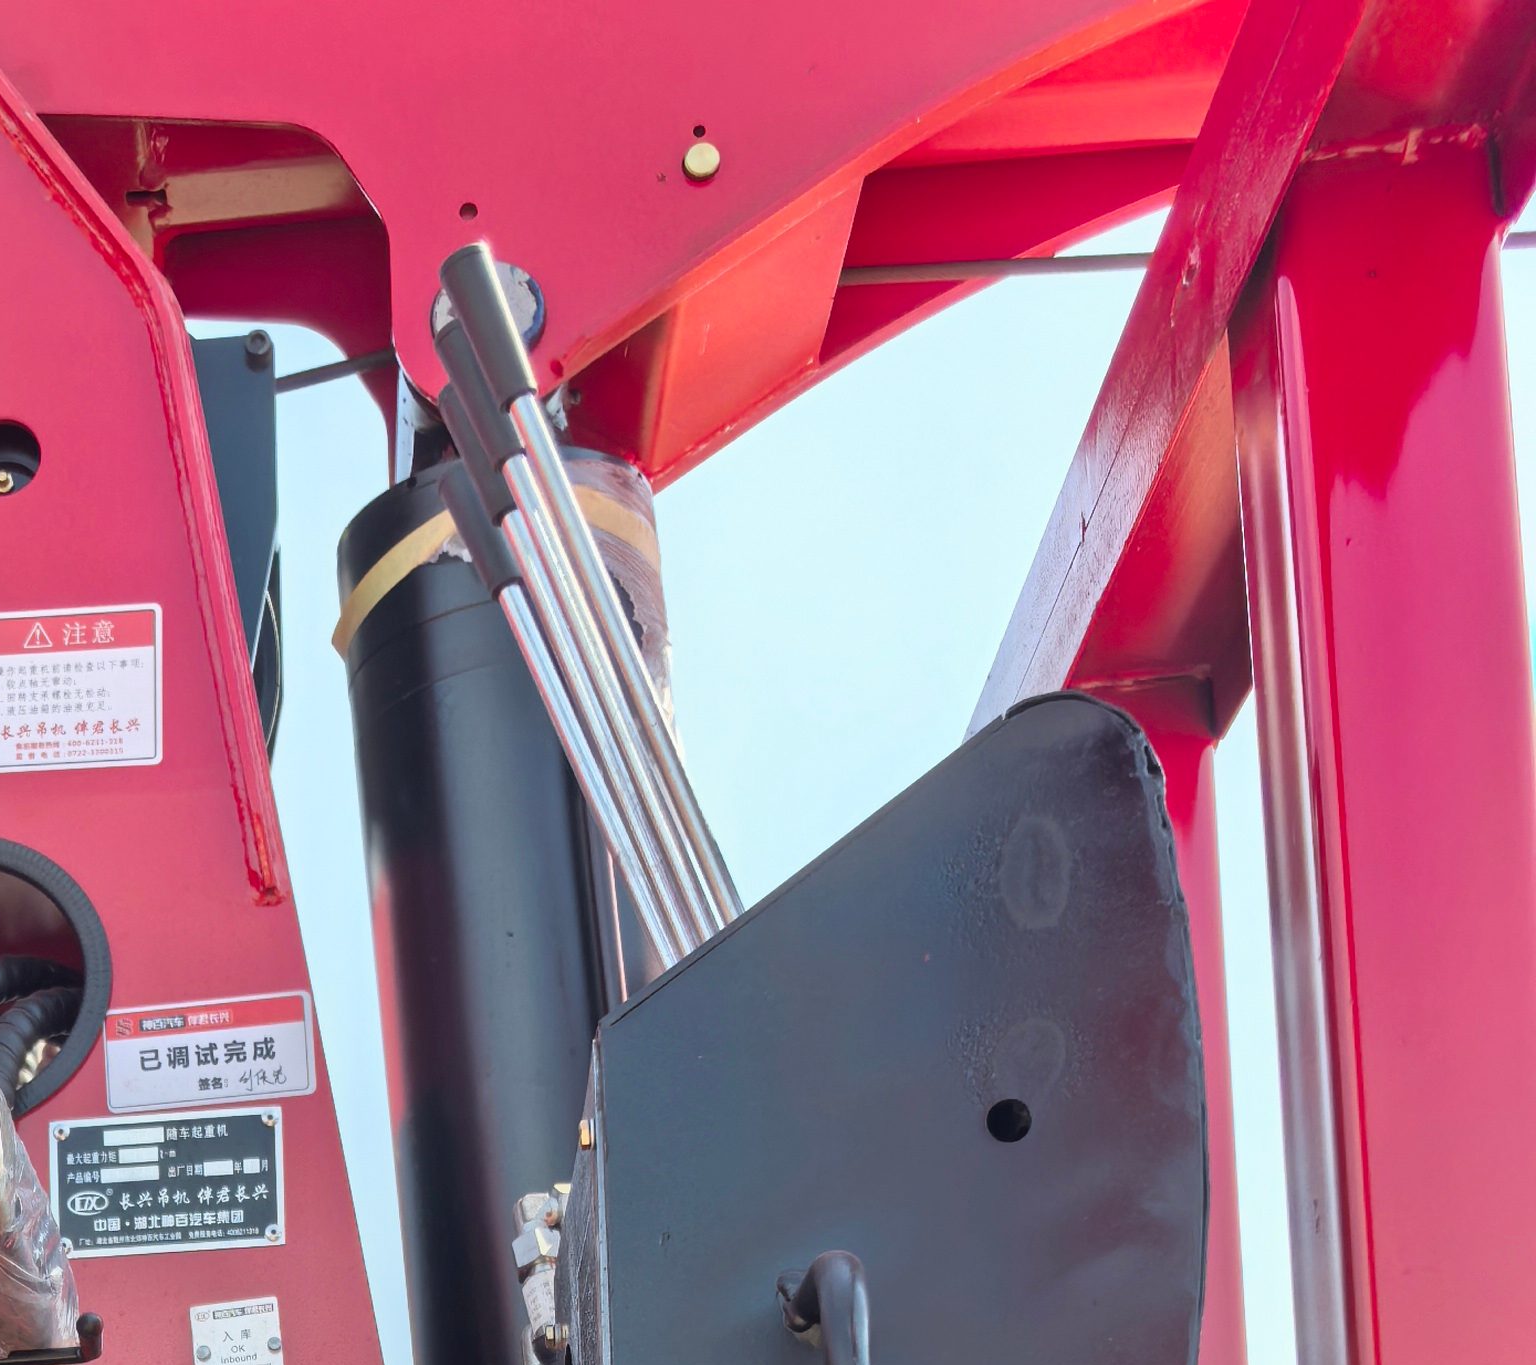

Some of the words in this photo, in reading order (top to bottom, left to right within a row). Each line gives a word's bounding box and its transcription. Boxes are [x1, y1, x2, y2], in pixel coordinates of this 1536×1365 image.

[62, 620, 115, 646] 注意
[1, 722, 66, 740] 长兴吊机
[75, 718, 140, 736] 伴君长兴
[140, 1038, 276, 1071] 已调试完成
[198, 1077, 229, 1091] 签名：
[166, 1124, 228, 1140] 随车起重机
[67, 1152, 117, 1165] 最大起重力矩
[67, 1171, 100, 1184] 产品编号
[168, 1163, 203, 1177] 出厂日期
[234, 1161, 242, 1172] 年
[261, 1159, 268, 1171] 月
[119, 1188, 190, 1210] 长兴吊机
[197, 1183, 269, 1205] 伴君长兴
[223, 1329, 251, 1342] 入库
[231, 1345, 245, 1353] OK
[221, 1353, 257, 1364] Inbound
